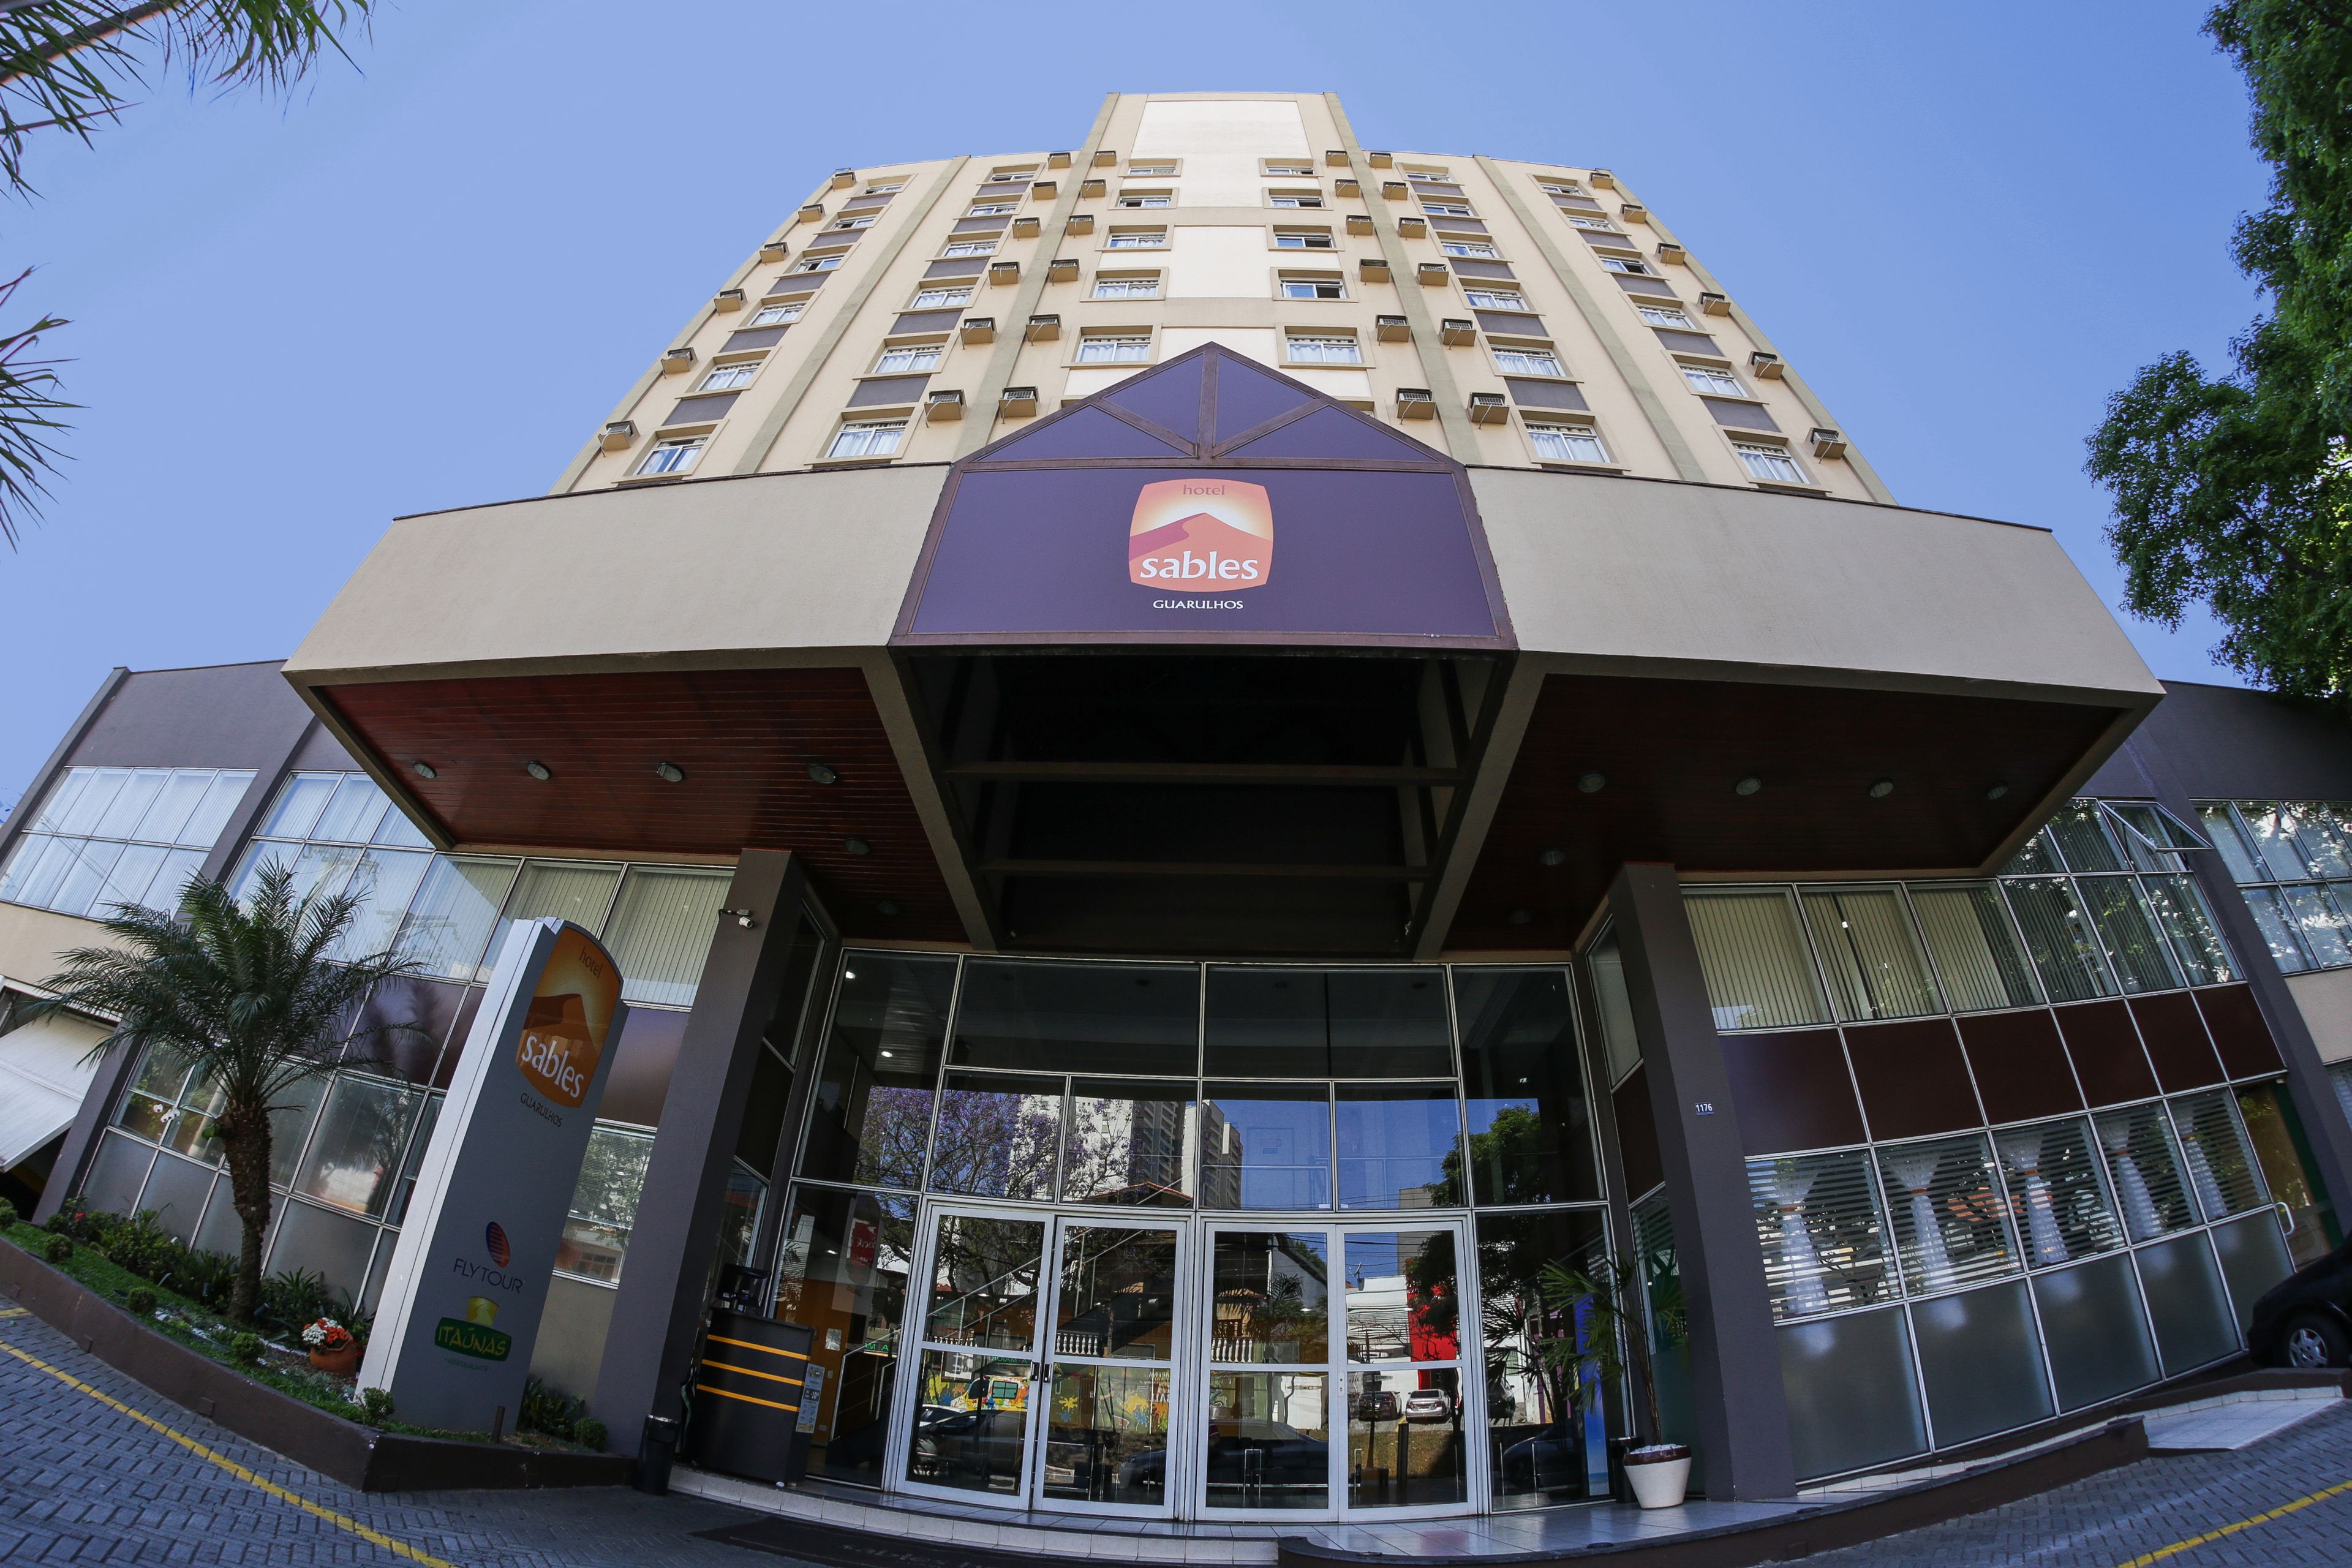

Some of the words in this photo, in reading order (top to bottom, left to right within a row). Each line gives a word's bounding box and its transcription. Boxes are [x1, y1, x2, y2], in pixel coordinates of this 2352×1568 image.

[1183, 484, 1226, 496] hotel
[1140, 551, 1259, 579] sables
[1153, 600, 1243, 609] GUARULHOS
[579, 947, 603, 979] hotel
[521, 1036, 584, 1098] sables
[520, 1093, 563, 1128] GUARULHOS
[1695, 1103, 1713, 1112] 1176
[453, 1258, 523, 1293] FLYTOUR
[438, 1326, 507, 1355] ITAÚNAS
